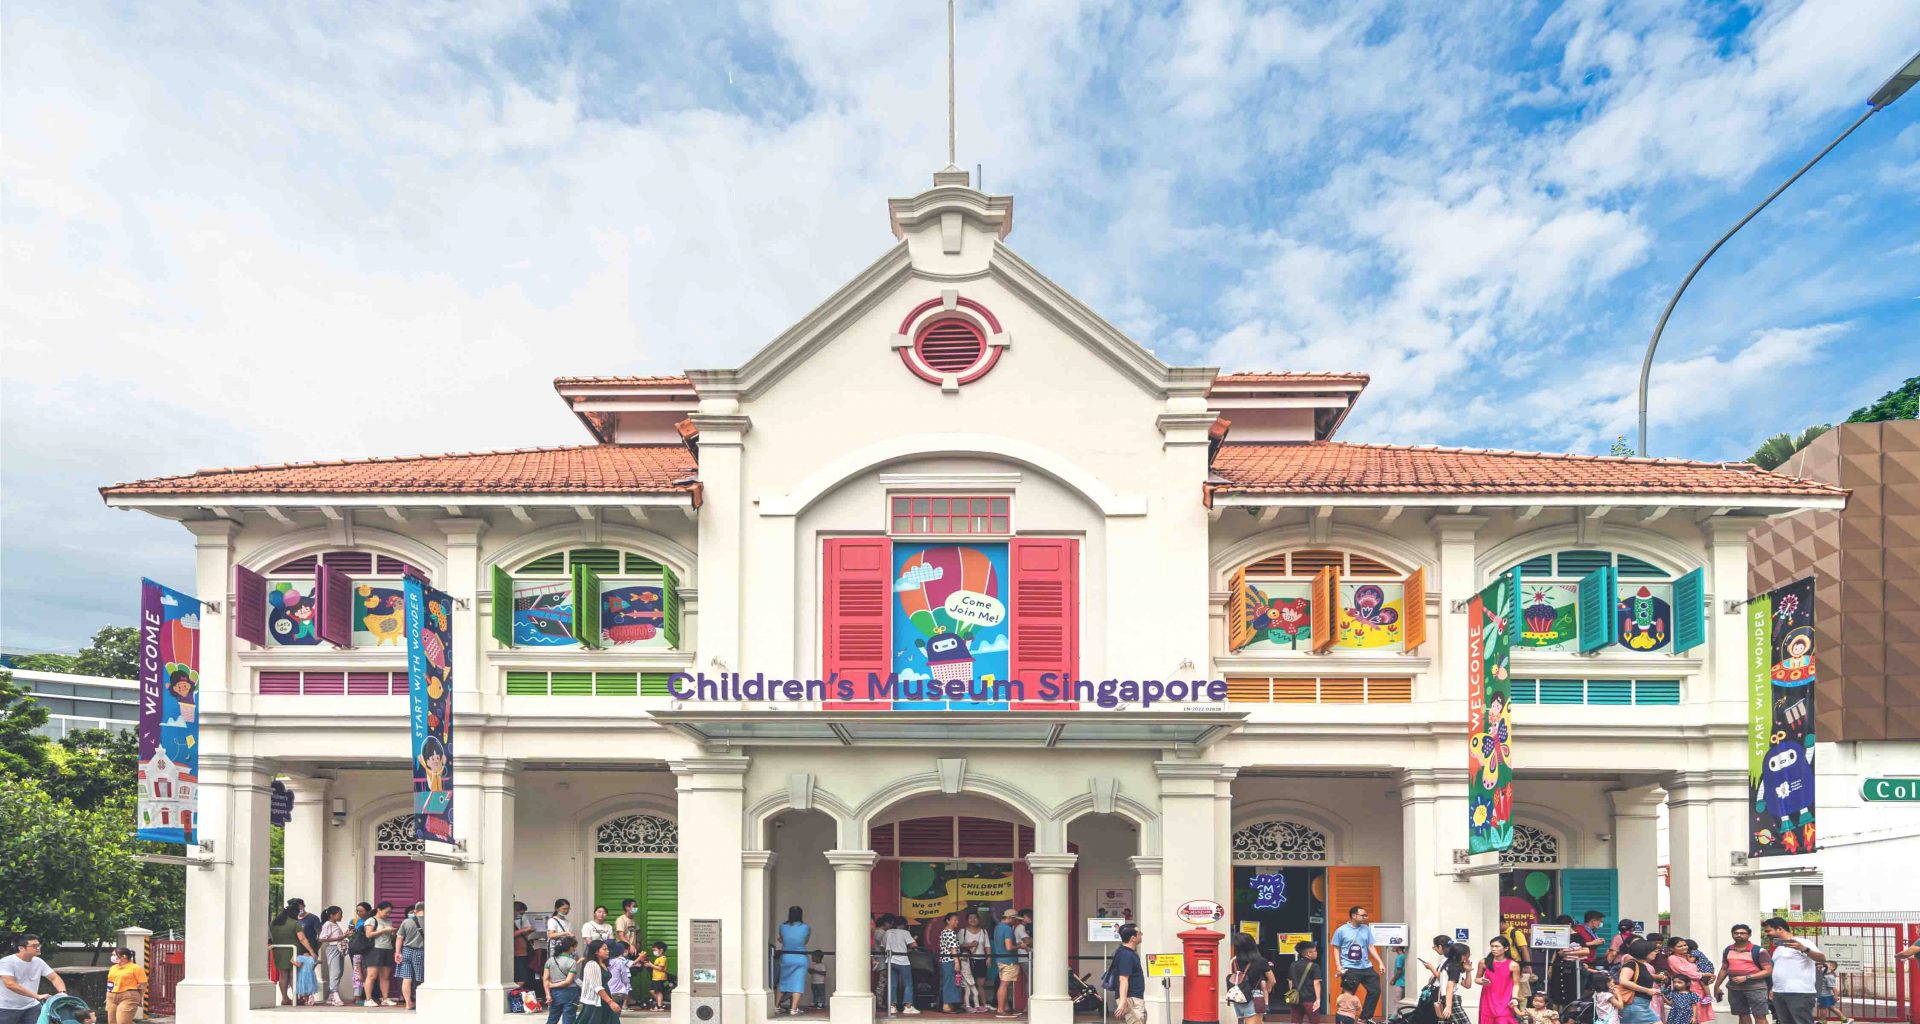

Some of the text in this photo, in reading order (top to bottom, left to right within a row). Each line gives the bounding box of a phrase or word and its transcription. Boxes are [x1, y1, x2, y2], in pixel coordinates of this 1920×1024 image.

[950, 605, 999, 623] Join Me!
[962, 596, 992, 609] Come
[145, 610, 161, 716] WELCOME
[410, 593, 423, 738] START WITH WONDER
[667, 672, 1228, 708] Children's Museum Singapore
[1470, 625, 1481, 731] WELCOME
[1754, 611, 1765, 756] START WITH WONDER
[1876, 781, 1916, 798] Col
[961, 881, 1012, 889] CHILDREN'S
[1258, 892, 1272, 900] SG
